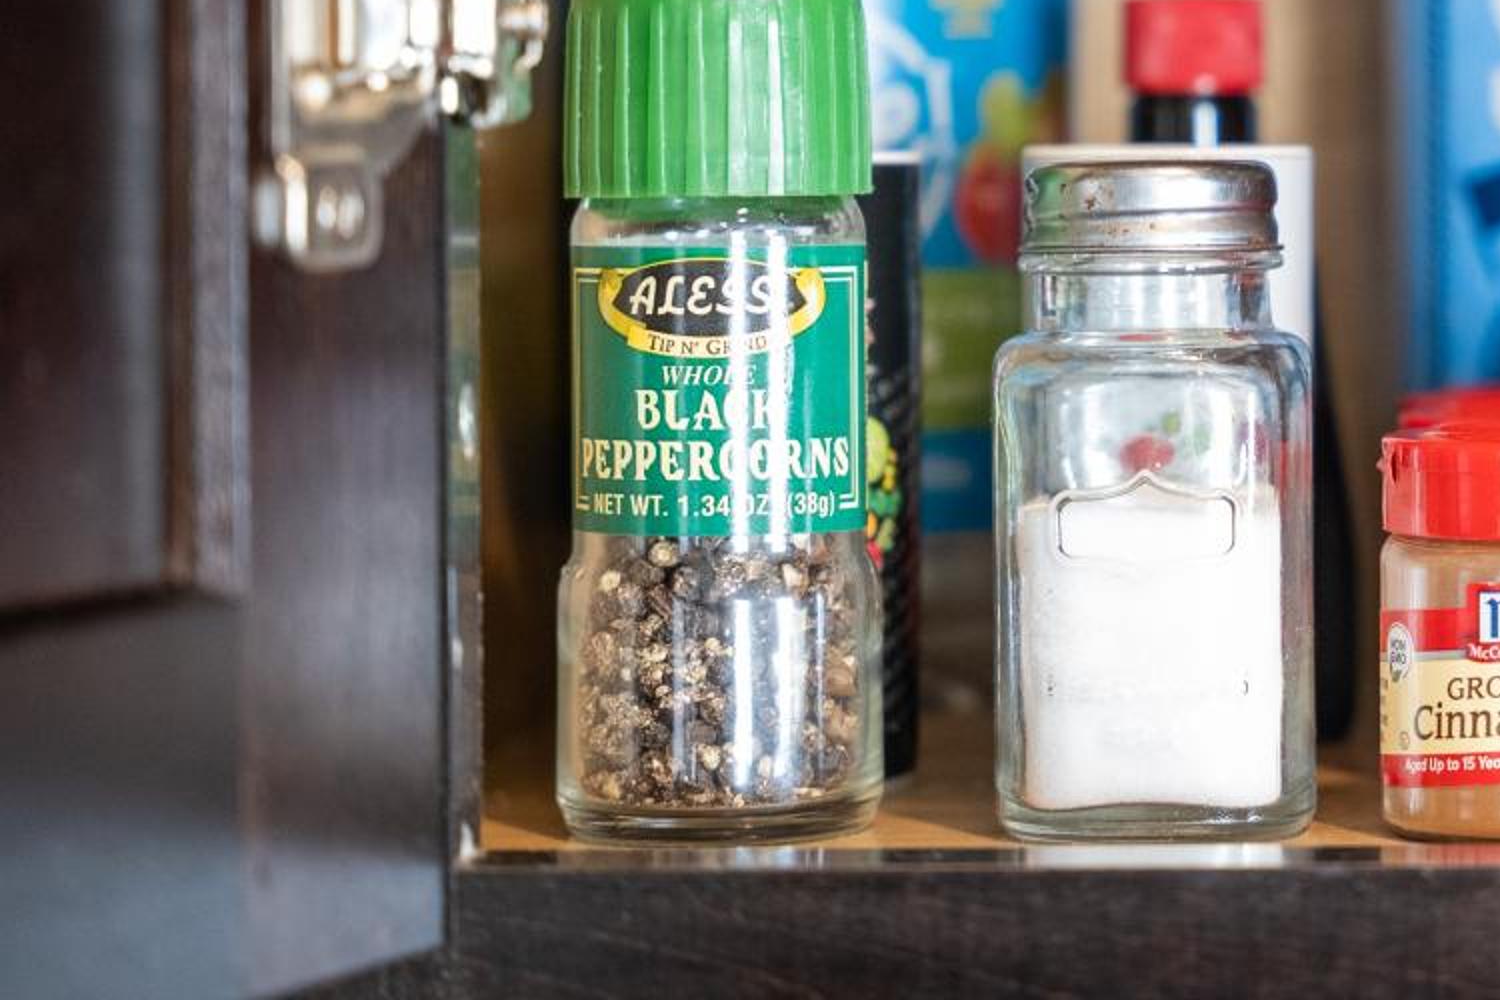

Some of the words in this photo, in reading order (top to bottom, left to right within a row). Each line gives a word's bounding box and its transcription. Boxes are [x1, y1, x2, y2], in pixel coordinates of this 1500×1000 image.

[629, 274, 794, 316] ALESS
[648, 333, 676, 353] TIP
[581, 436, 850, 482] PEPPERCORNS
[593, 493, 624, 515] NET
[630, 493, 669, 517] WT.
[678, 494, 732, 517] 1.34
[1429, 756, 1445, 775] Up
[1447, 757, 1460, 771] to
[1462, 755, 1477, 771] 15
